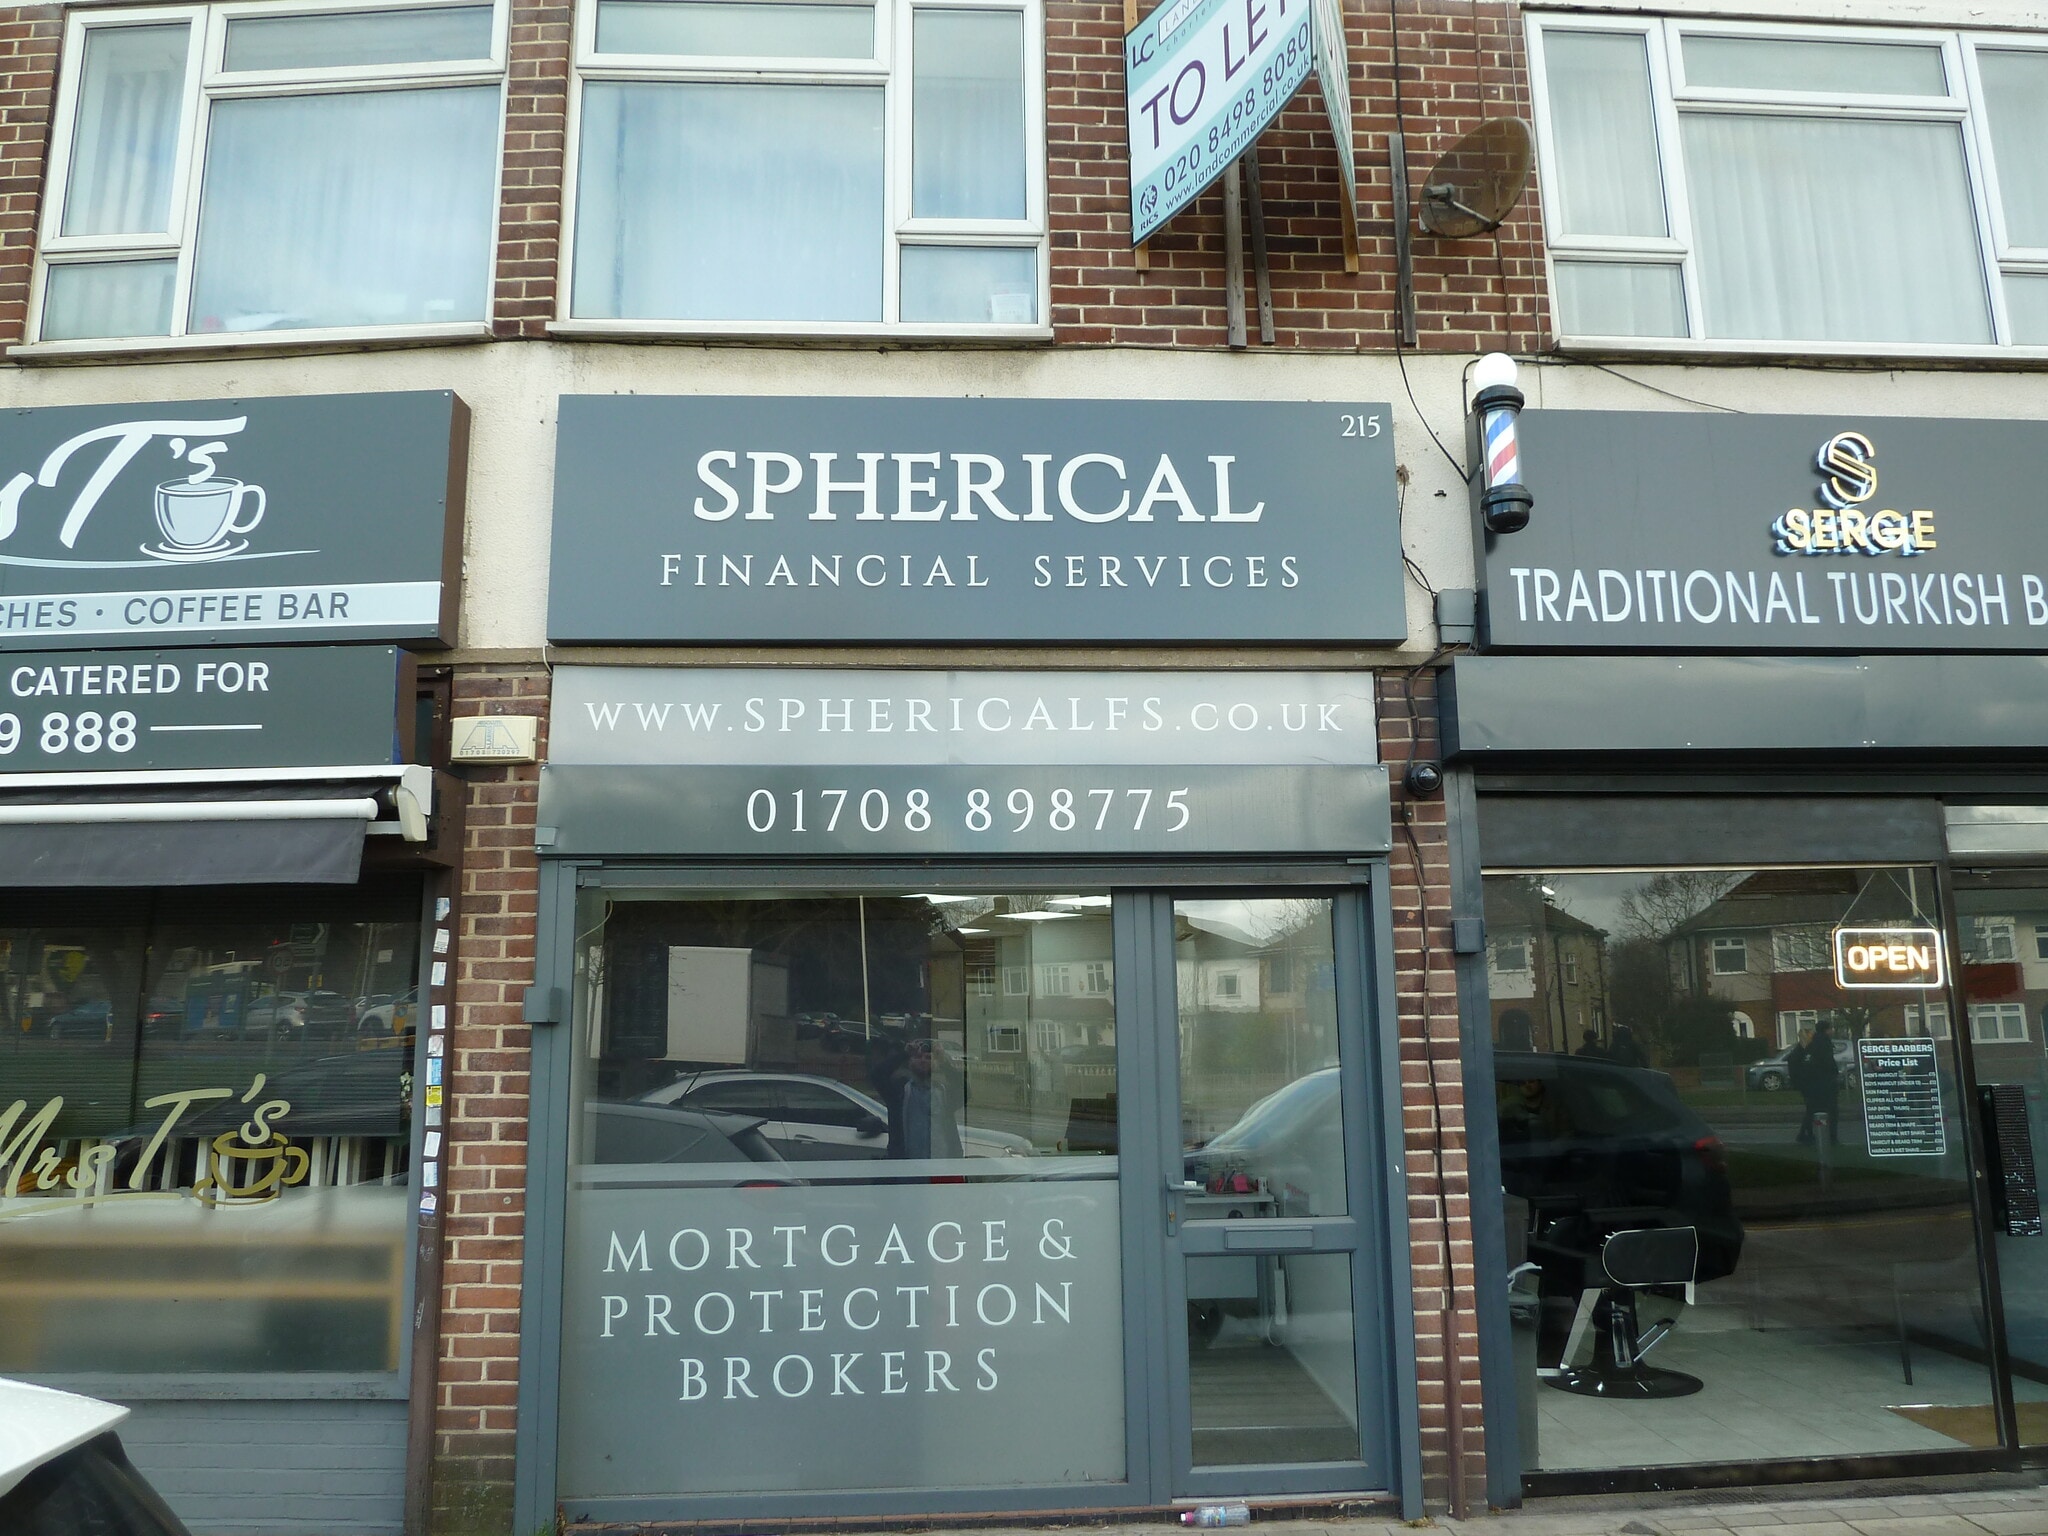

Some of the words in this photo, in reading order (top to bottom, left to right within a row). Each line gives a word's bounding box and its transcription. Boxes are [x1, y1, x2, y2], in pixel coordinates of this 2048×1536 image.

[1141, 60, 1206, 150] TO
[1223, 0, 1286, 82] LE
[1164, 143, 1200, 192] 020
[1208, 88, 1255, 154] 8498
[1263, 22, 1308, 96] 8080
[1165, 57, 1310, 211] www.landcommercial.co.uk
[1140, 212, 1159, 231] RICS
[1340, 413, 1382, 438] 215
[692, 449, 1266, 524] SPHERICAL
[1781, 508, 1938, 553] SERGE
[660, 553, 990, 588] FINANCIAL
[1034, 554, 1301, 588] SERVICES
[0, 600, 78, 630] HES
[123, 594, 262, 626] COFFEE
[277, 592, 350, 621] BAR
[1510, 567, 1821, 625] TRADITIONAL
[1827, 571, 2010, 625] TURKISH
[10, 664, 181, 697] CATERED
[196, 662, 270, 693] FOR
[40, 711, 137, 754] 888
[746, 788, 934, 834] 01708
[964, 786, 1192, 833] 898775
[1847, 945, 1930, 971] OPEN
[1861, 1045, 1891, 1053] SERGE
[1892, 1044, 1933, 1052] BARBERS
[1878, 1058, 1900, 1067] Price
[1902, 1058, 1918, 1066] List
[0, 1095, 117, 1199] Mrs
[128, 1073, 291, 1189] T's
[602, 1220, 1010, 1273] MORTGAGE
[1037, 1217, 1078, 1261] &
[600, 1281, 1074, 1338] PROTECTION
[679, 1347, 999, 1402] BROKERS
